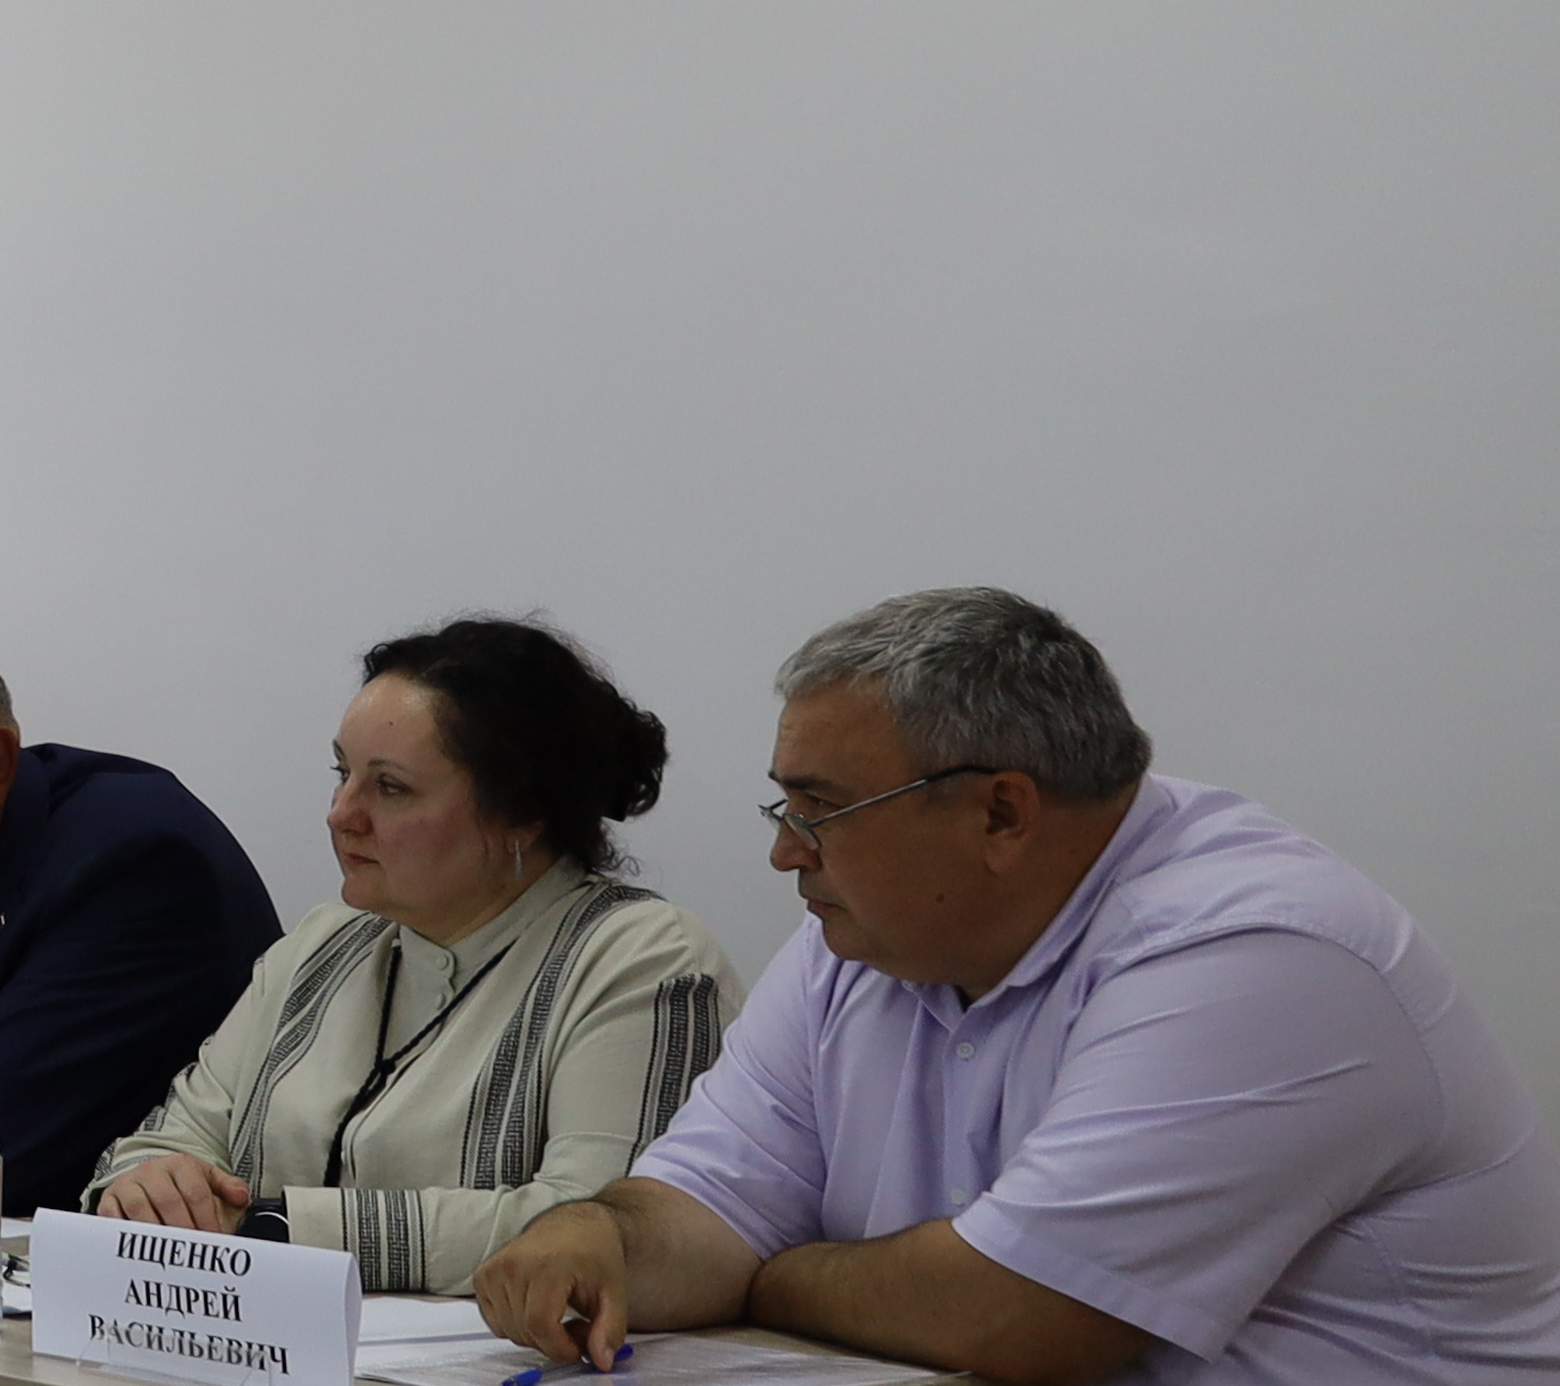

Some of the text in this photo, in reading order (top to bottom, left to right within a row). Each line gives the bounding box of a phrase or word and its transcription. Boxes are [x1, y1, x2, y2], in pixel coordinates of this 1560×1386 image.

[116, 1231, 252, 1277] ИЩЕНКО
[124, 1279, 242, 1322] АНДРЕЙ
[88, 1314, 291, 1375] ВАСИЛЬЕВИЧ
